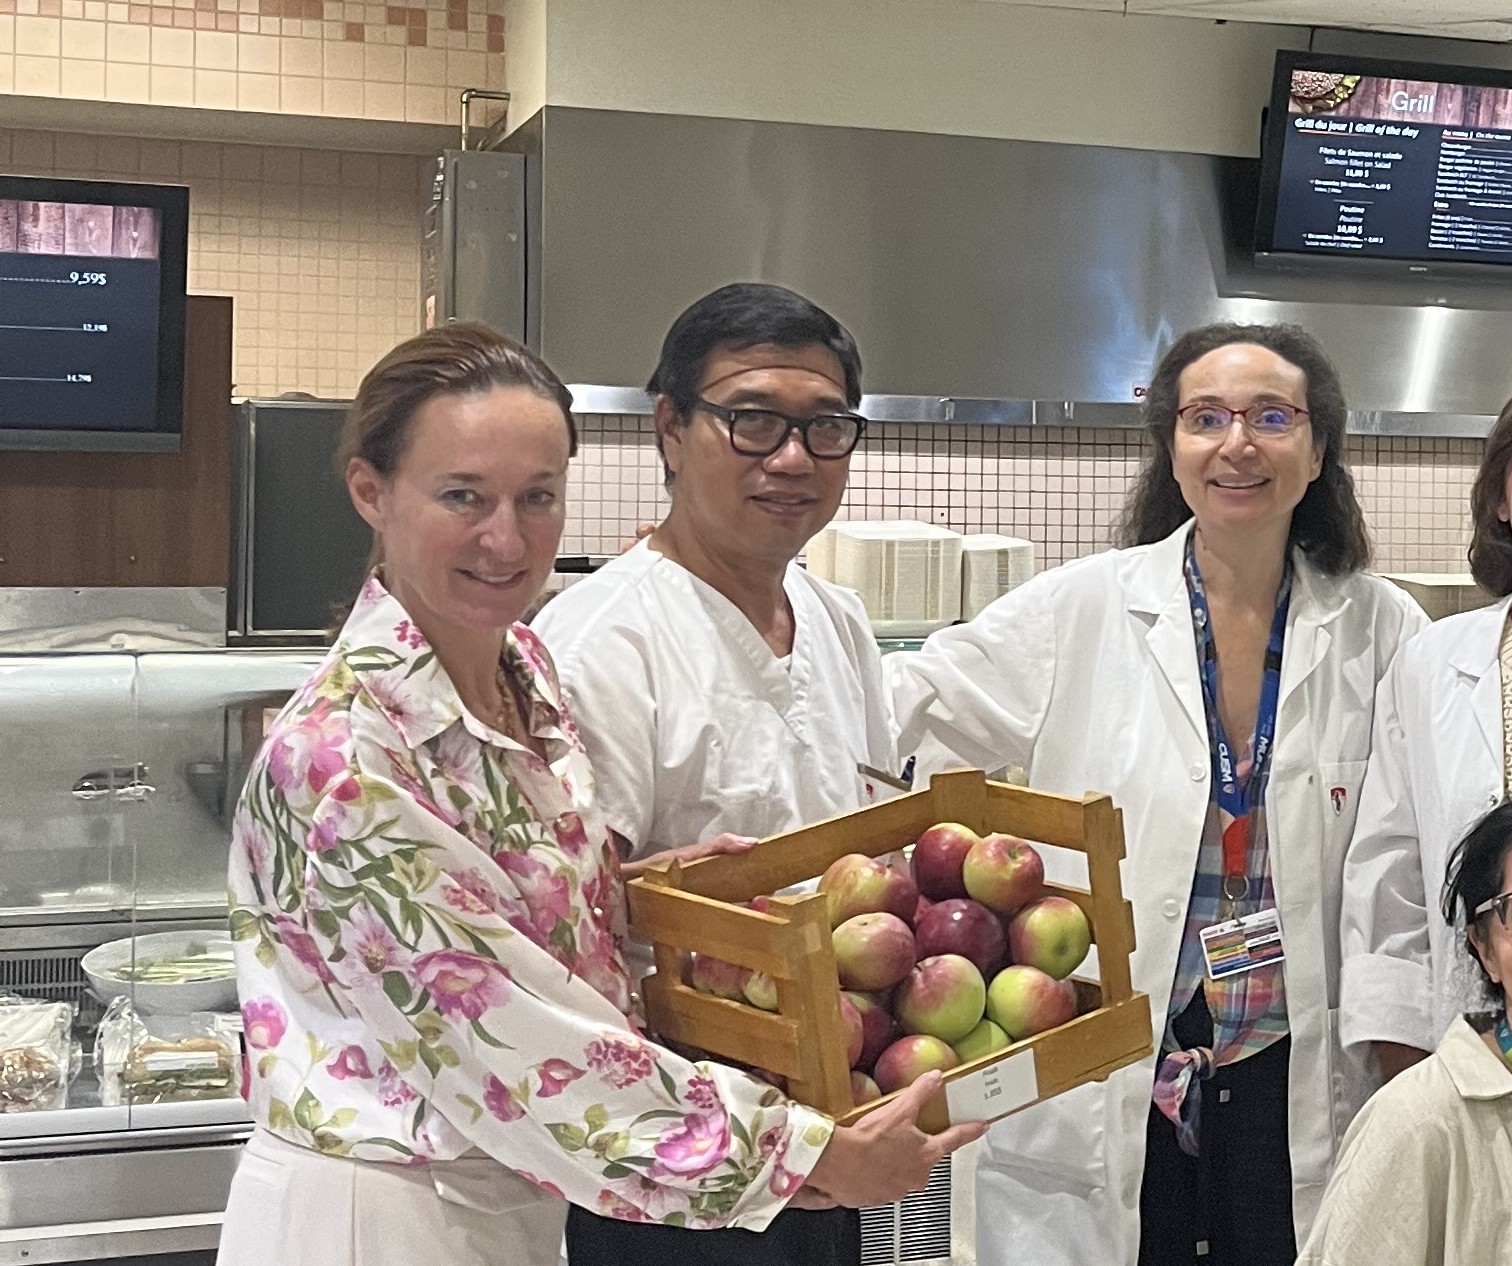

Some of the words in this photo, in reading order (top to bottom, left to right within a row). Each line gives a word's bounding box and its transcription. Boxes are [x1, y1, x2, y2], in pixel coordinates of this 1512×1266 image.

[1392, 91, 1434, 112] Grill
[1295, 118, 1314, 128] Grill
[1355, 122, 1375, 133] Grill
[1375, 124, 1386, 136] of
[1386, 125, 1401, 136] the
[1402, 127, 1420, 139] day
[70, 272, 106, 286] 9,59$
[1218, 743, 1233, 782] CUSM
